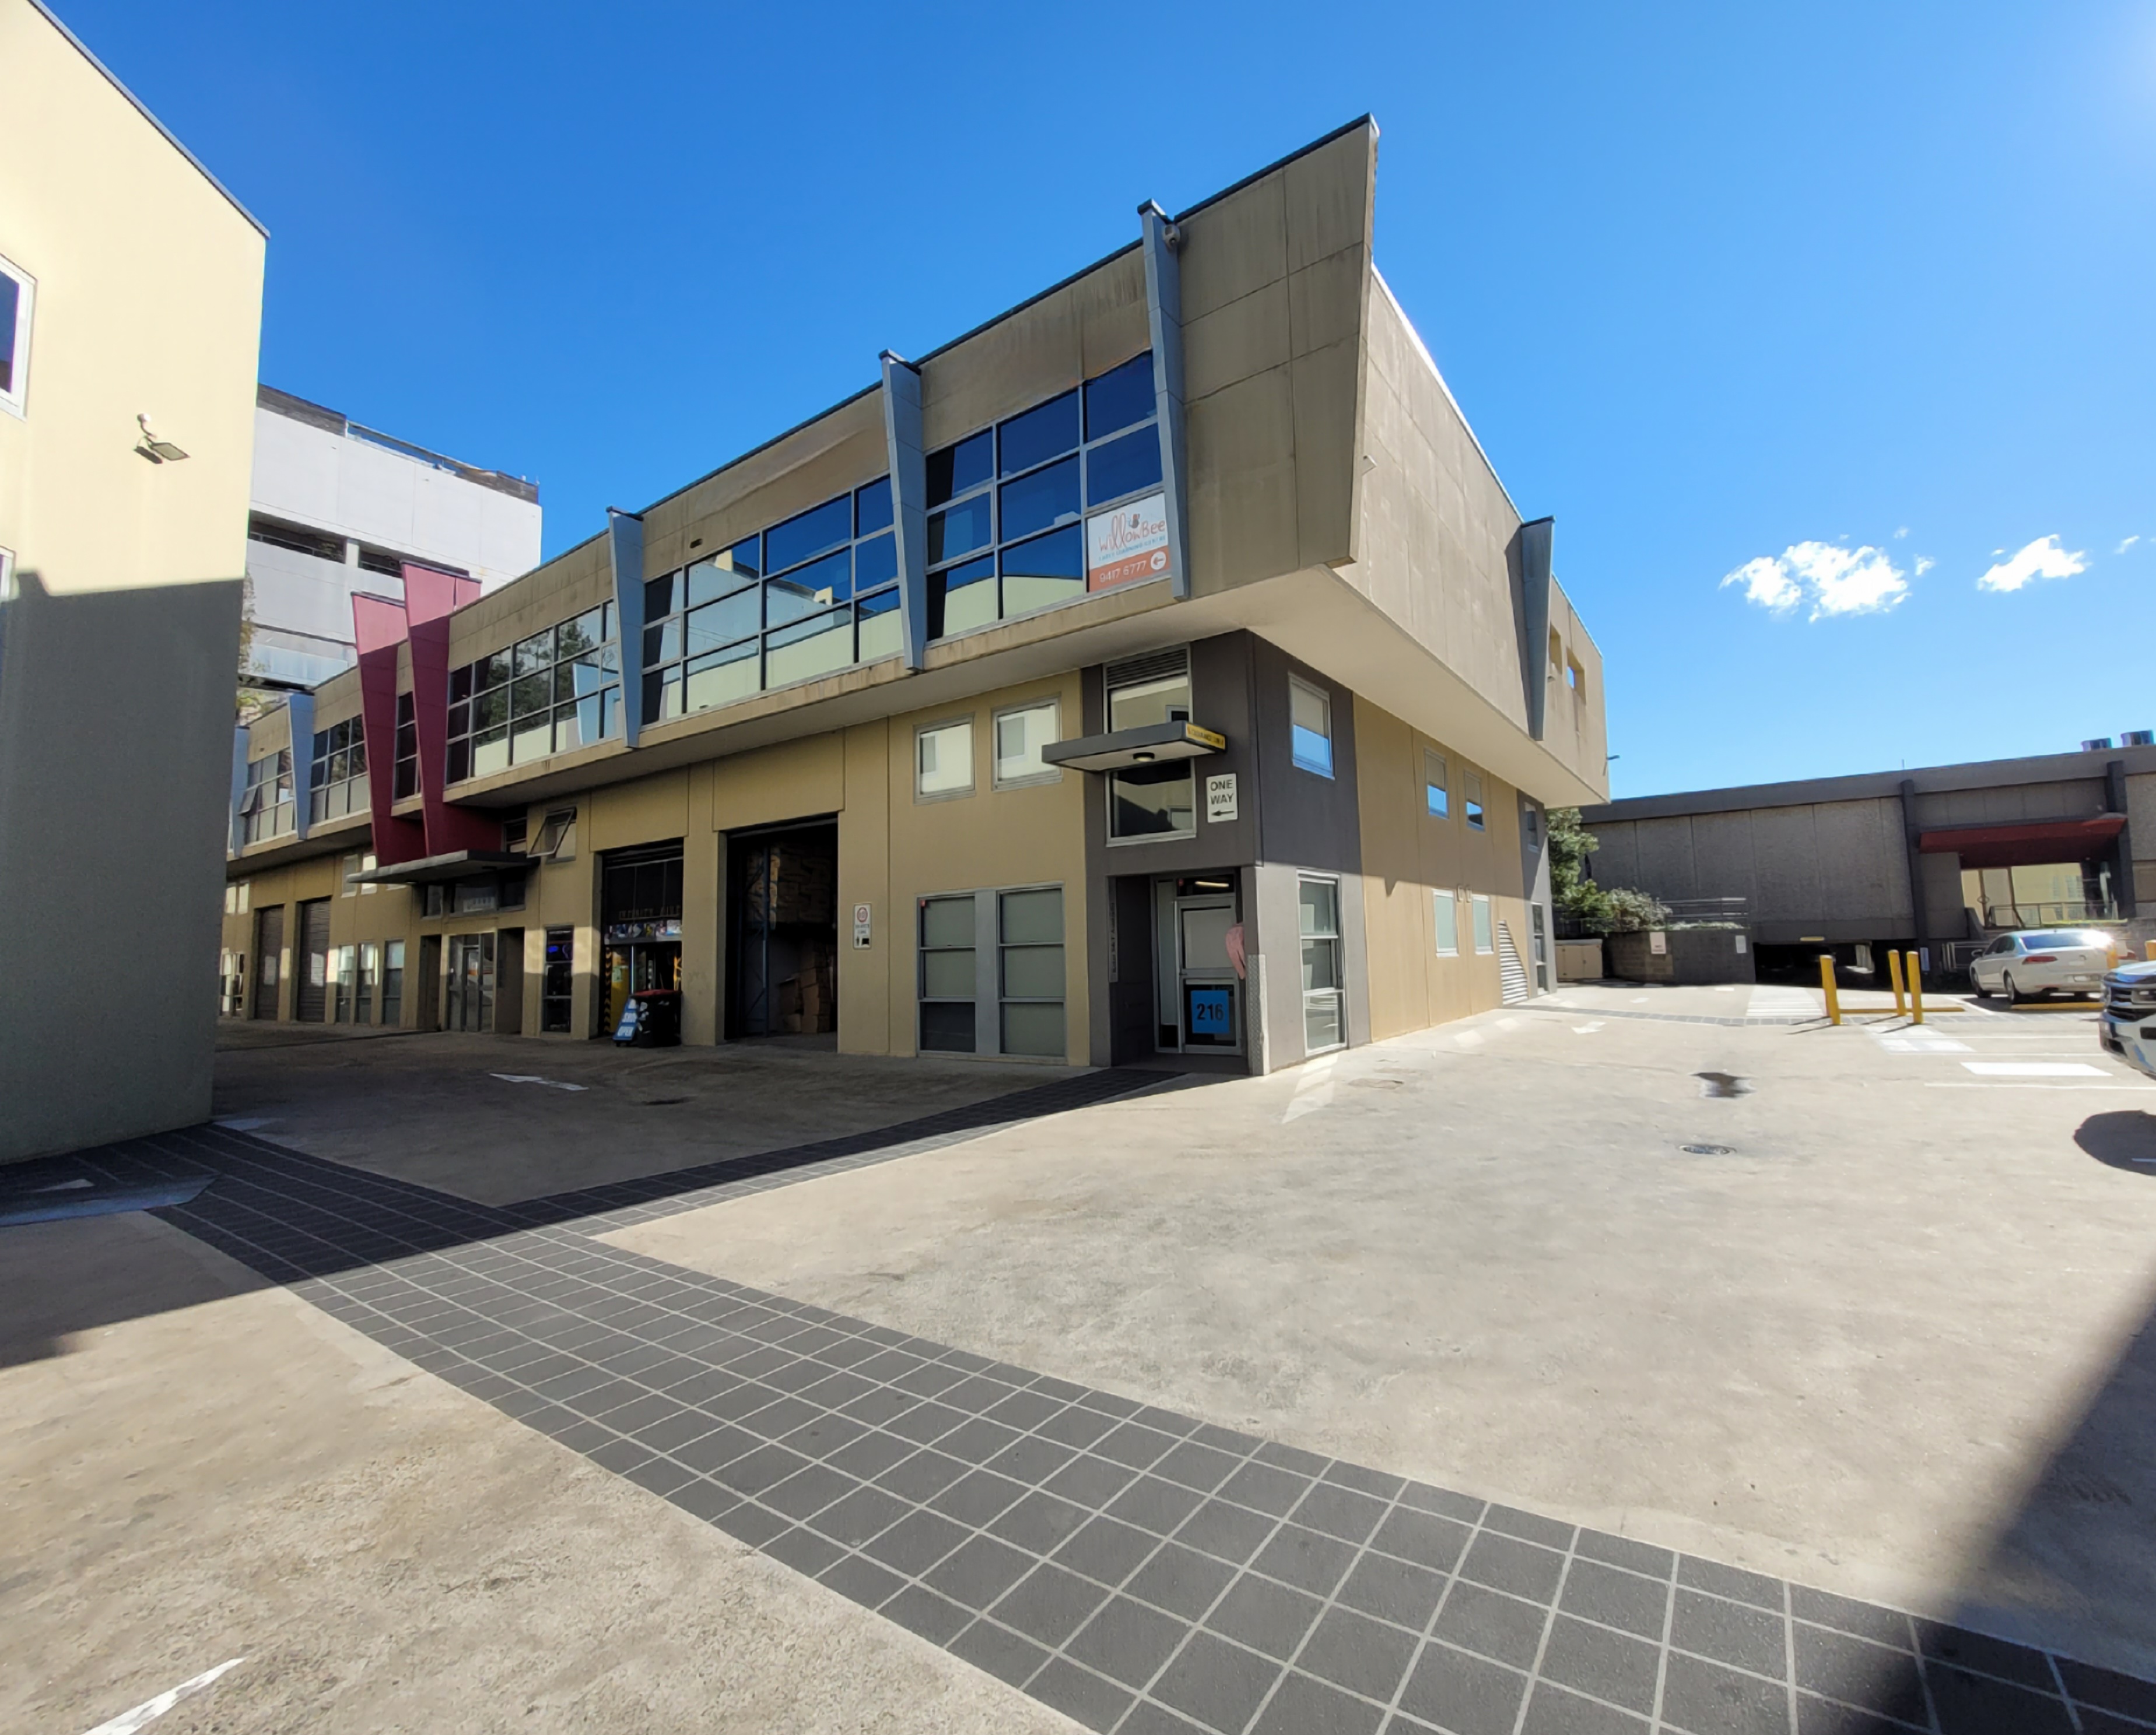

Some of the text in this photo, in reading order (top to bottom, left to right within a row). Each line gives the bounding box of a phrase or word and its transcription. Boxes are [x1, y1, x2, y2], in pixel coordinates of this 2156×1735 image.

[1099, 560, 1147, 583] 9417 6777
[1210, 779, 1233, 791] ONE
[1210, 793, 1234, 805] WAY
[1197, 1003, 1224, 1021] 216
